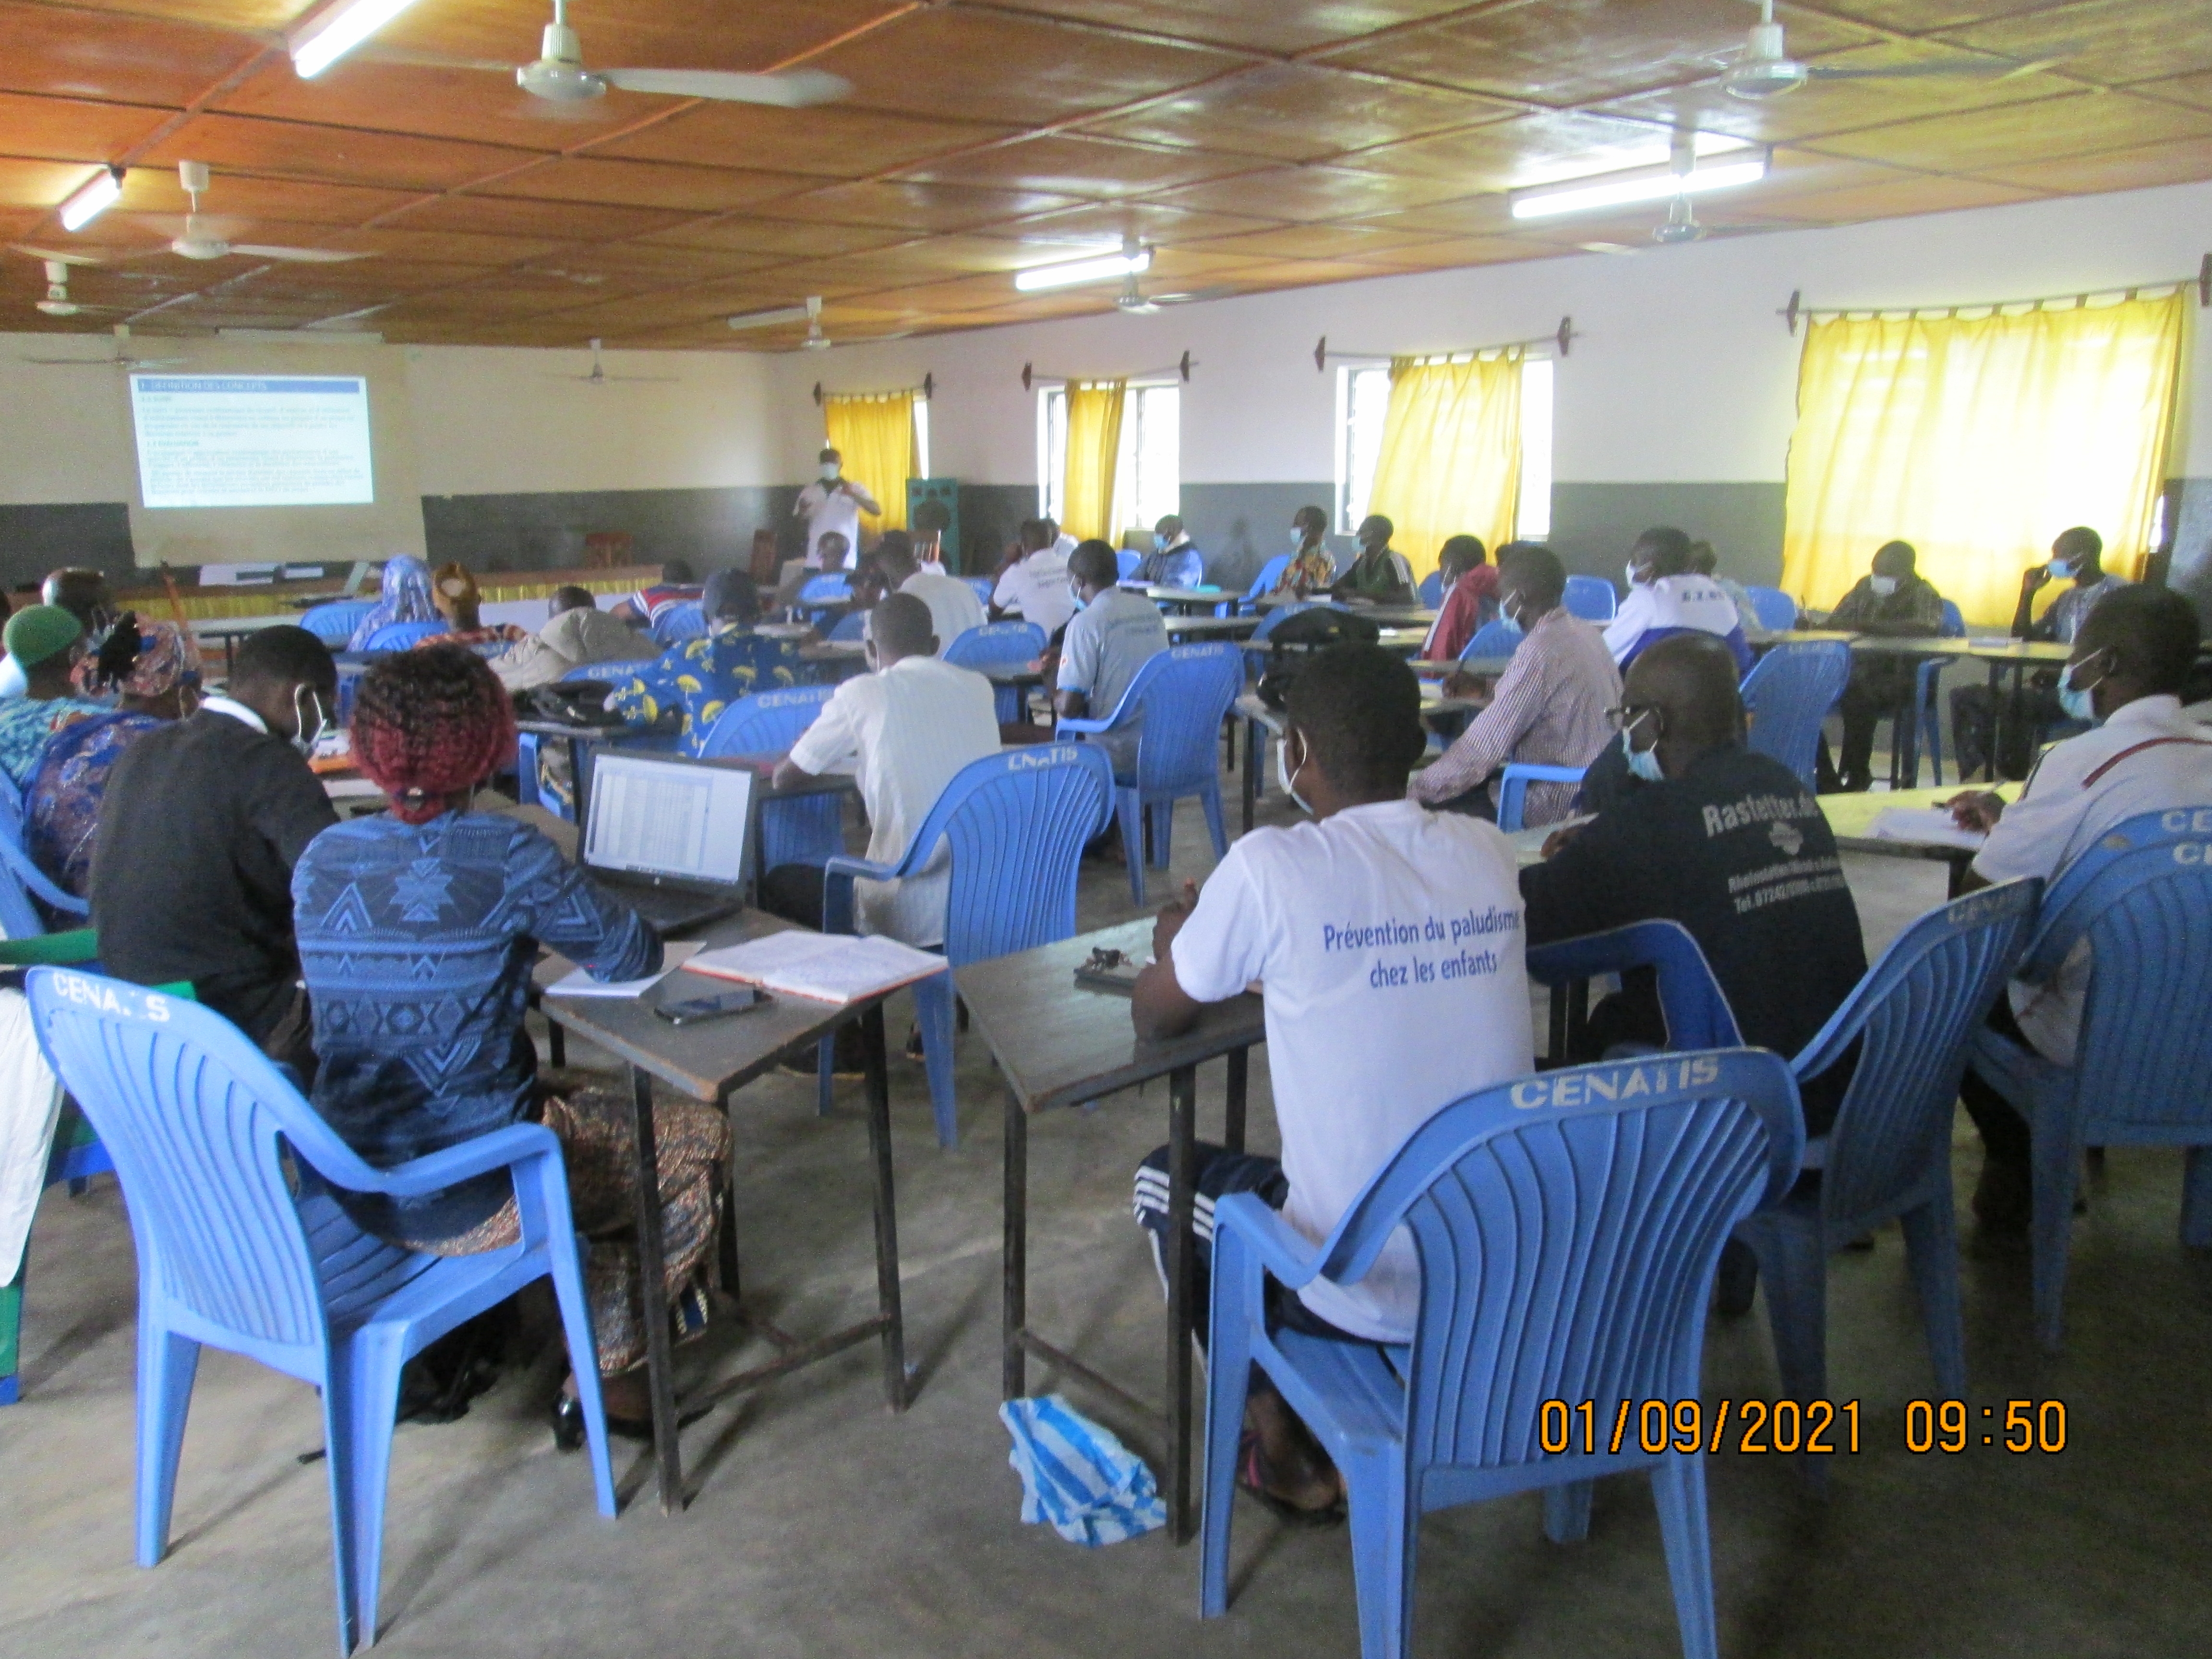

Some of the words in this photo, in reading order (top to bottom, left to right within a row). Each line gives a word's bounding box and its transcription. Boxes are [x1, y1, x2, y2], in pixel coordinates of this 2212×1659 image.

[1323, 916, 1419, 952] Prévention
[1424, 915, 1446, 941] du
[1370, 958, 1409, 988] chez
[1412, 955, 1436, 984] les
[1441, 949, 1498, 980] enfants
